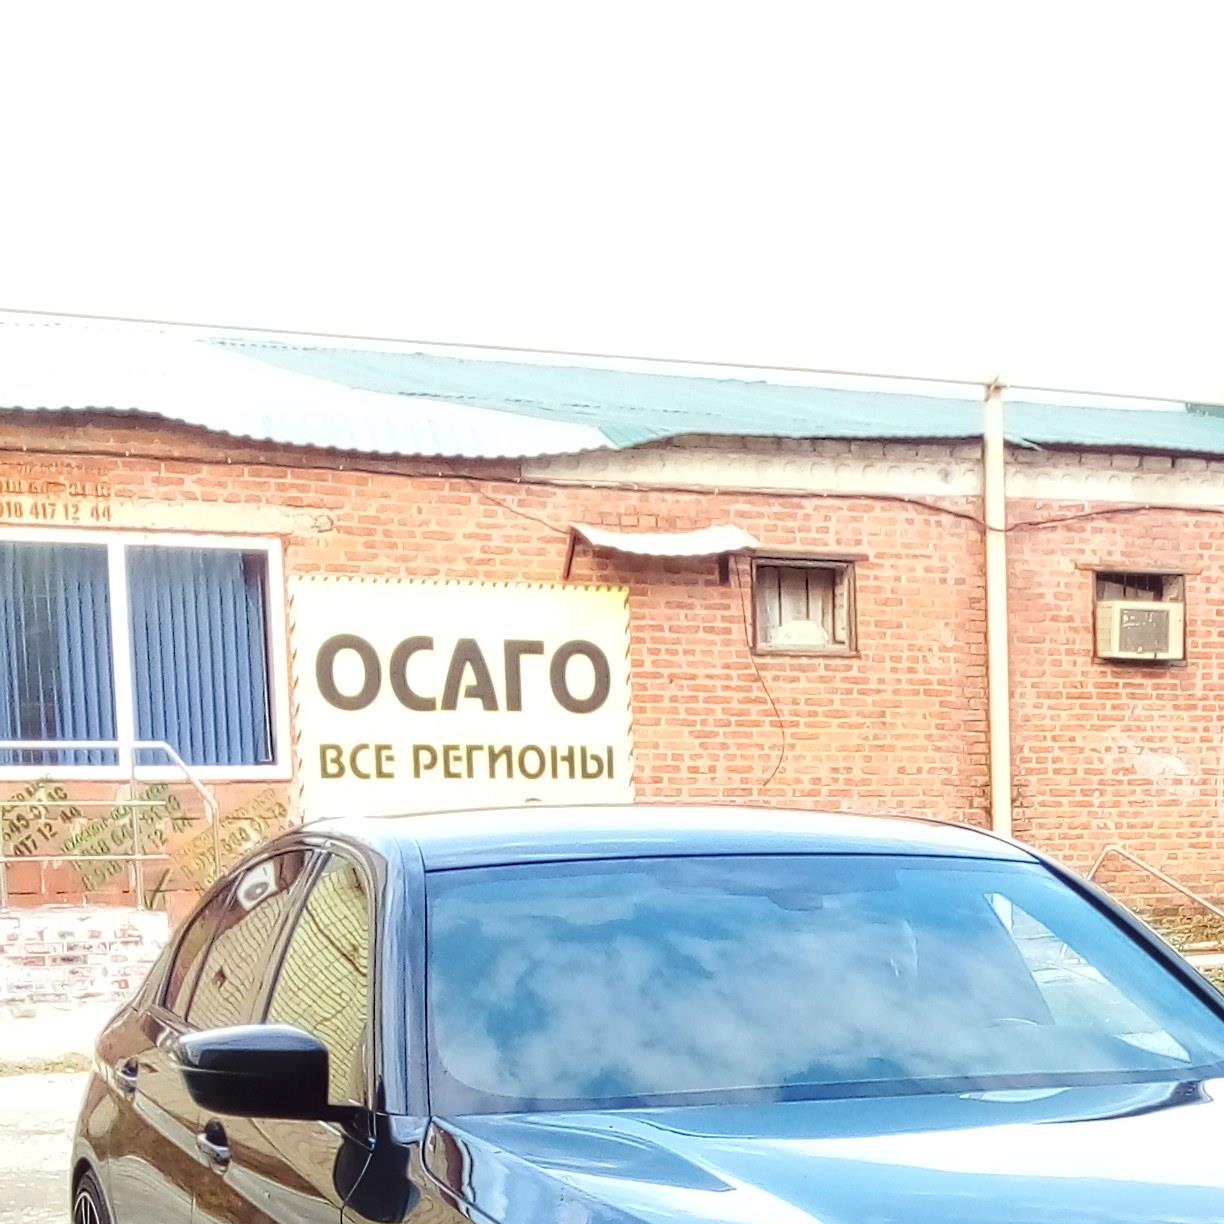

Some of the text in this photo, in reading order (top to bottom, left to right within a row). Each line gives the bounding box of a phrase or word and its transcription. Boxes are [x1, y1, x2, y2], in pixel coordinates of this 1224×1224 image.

[30, 502, 56, 520] 417
[63, 502, 80, 521] 12
[90, 503, 111, 522] 44
[316, 633, 611, 714] ОСАГО
[319, 743, 614, 779] ВСЕ РЕГИОНЫ
